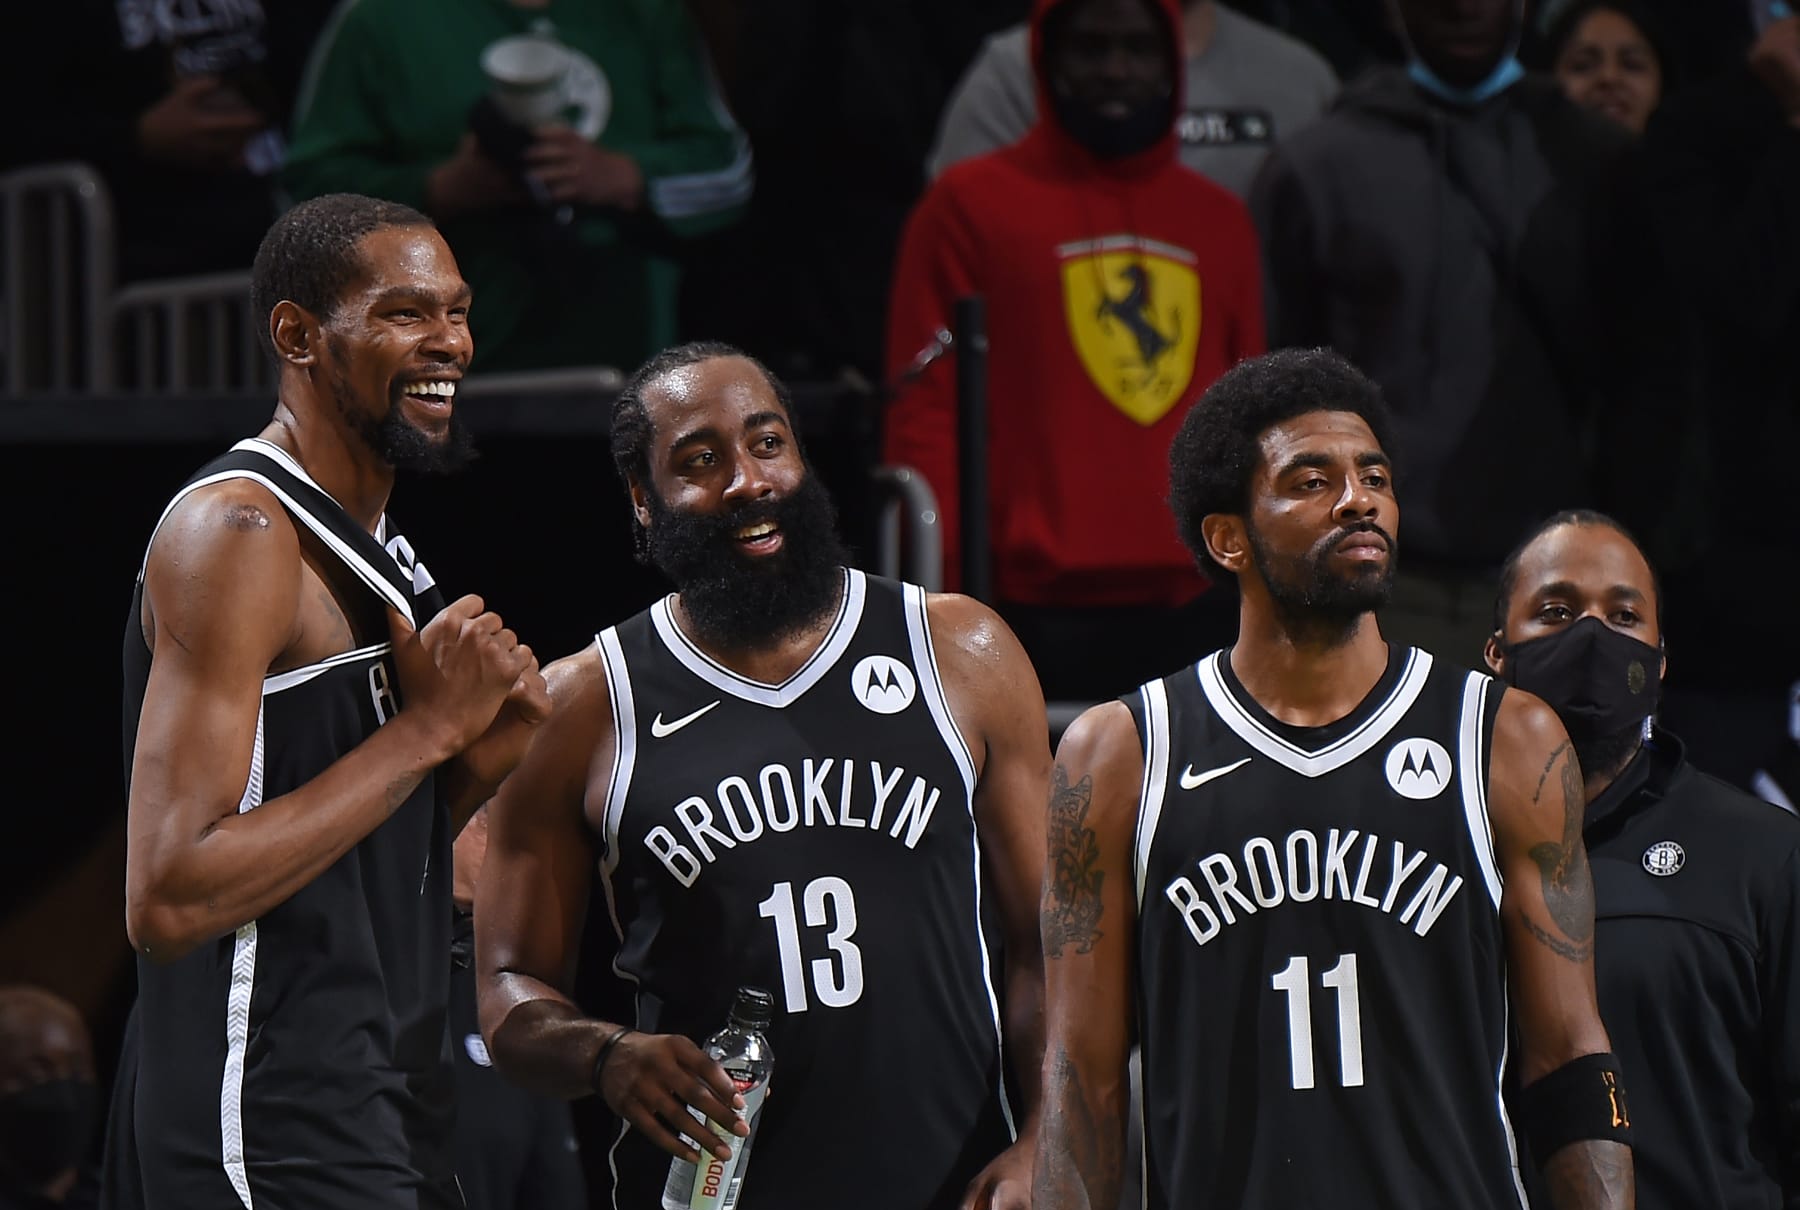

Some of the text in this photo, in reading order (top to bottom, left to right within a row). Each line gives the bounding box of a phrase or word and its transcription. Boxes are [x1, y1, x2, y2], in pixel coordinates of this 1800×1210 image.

[643, 757, 942, 889] BROOKLYN
[1165, 828, 1465, 947] BROOKLYN
[757, 875, 865, 1014] 13
[1271, 952, 1365, 1091] 11
